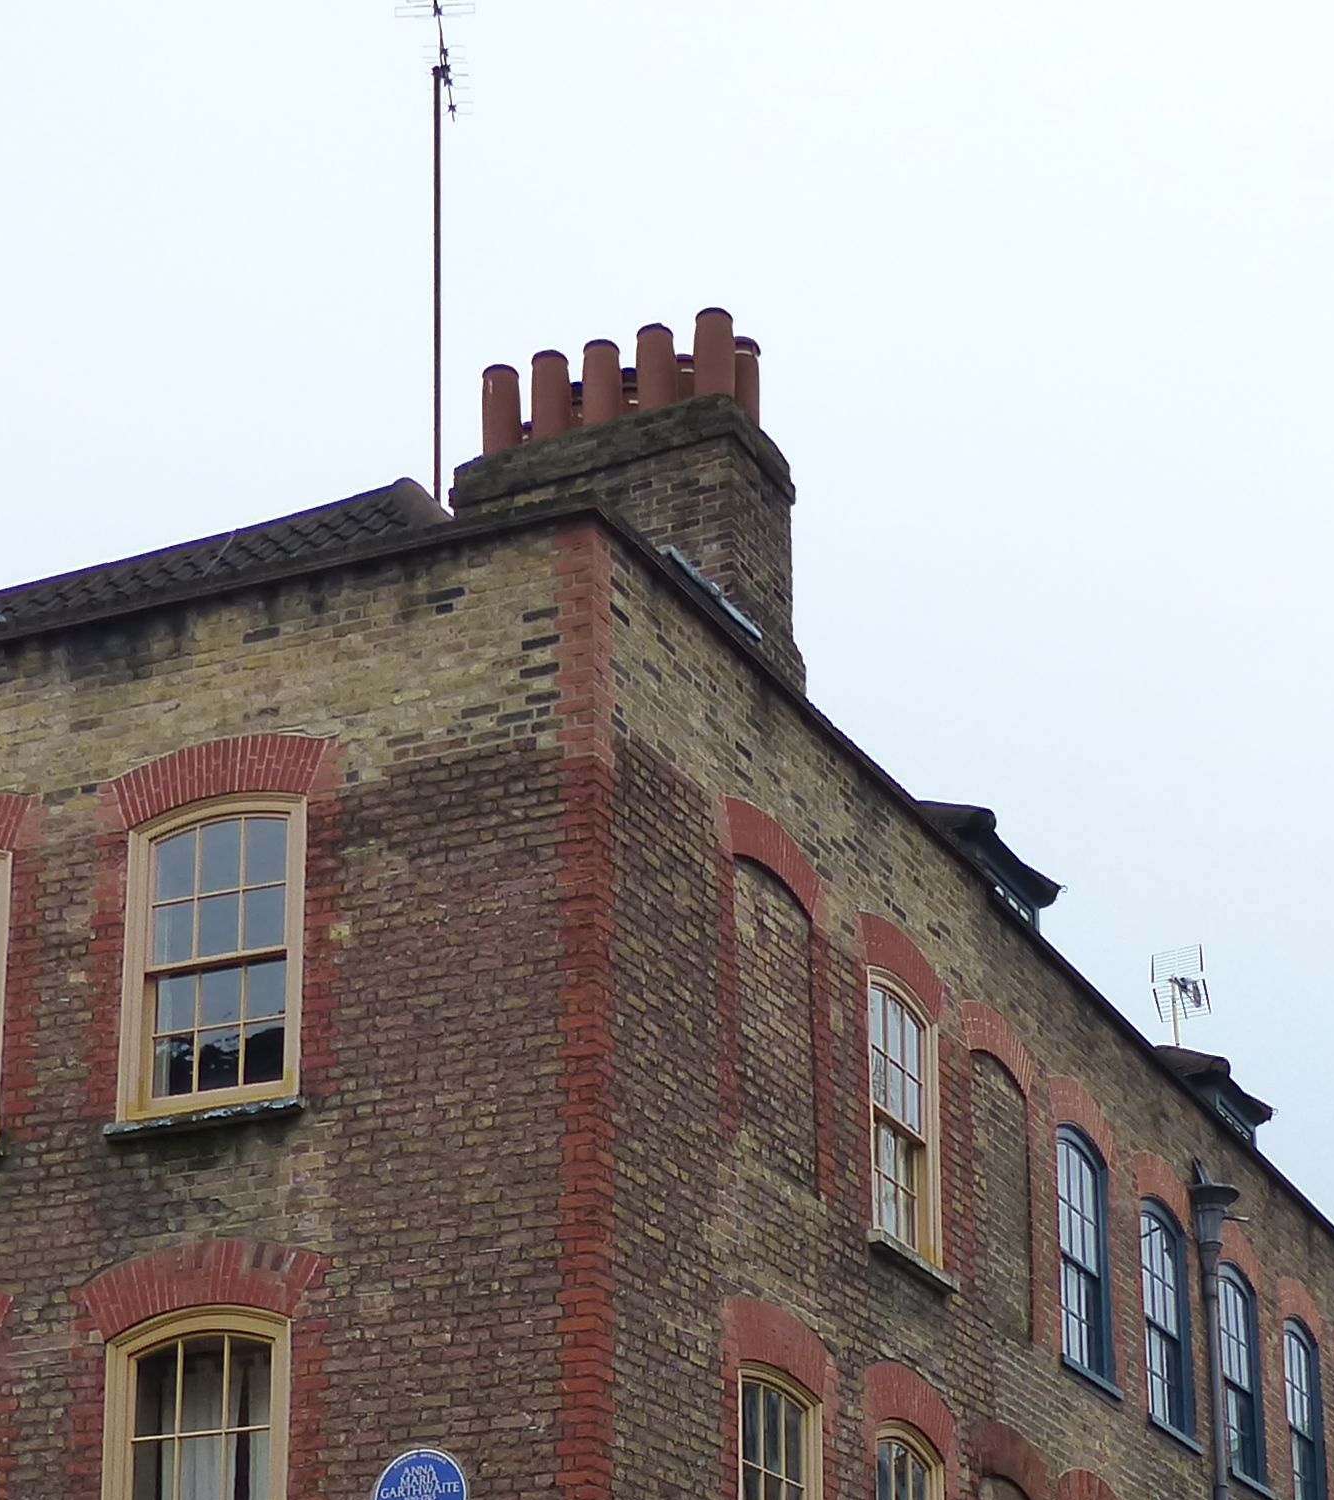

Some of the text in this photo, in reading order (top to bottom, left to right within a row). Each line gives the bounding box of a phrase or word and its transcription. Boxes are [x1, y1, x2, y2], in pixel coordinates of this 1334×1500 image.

[403, 1464, 435, 1476] ANNA
[400, 1472, 439, 1488] MARIA
[380, 1482, 460, 1499] GARTHWAITE
